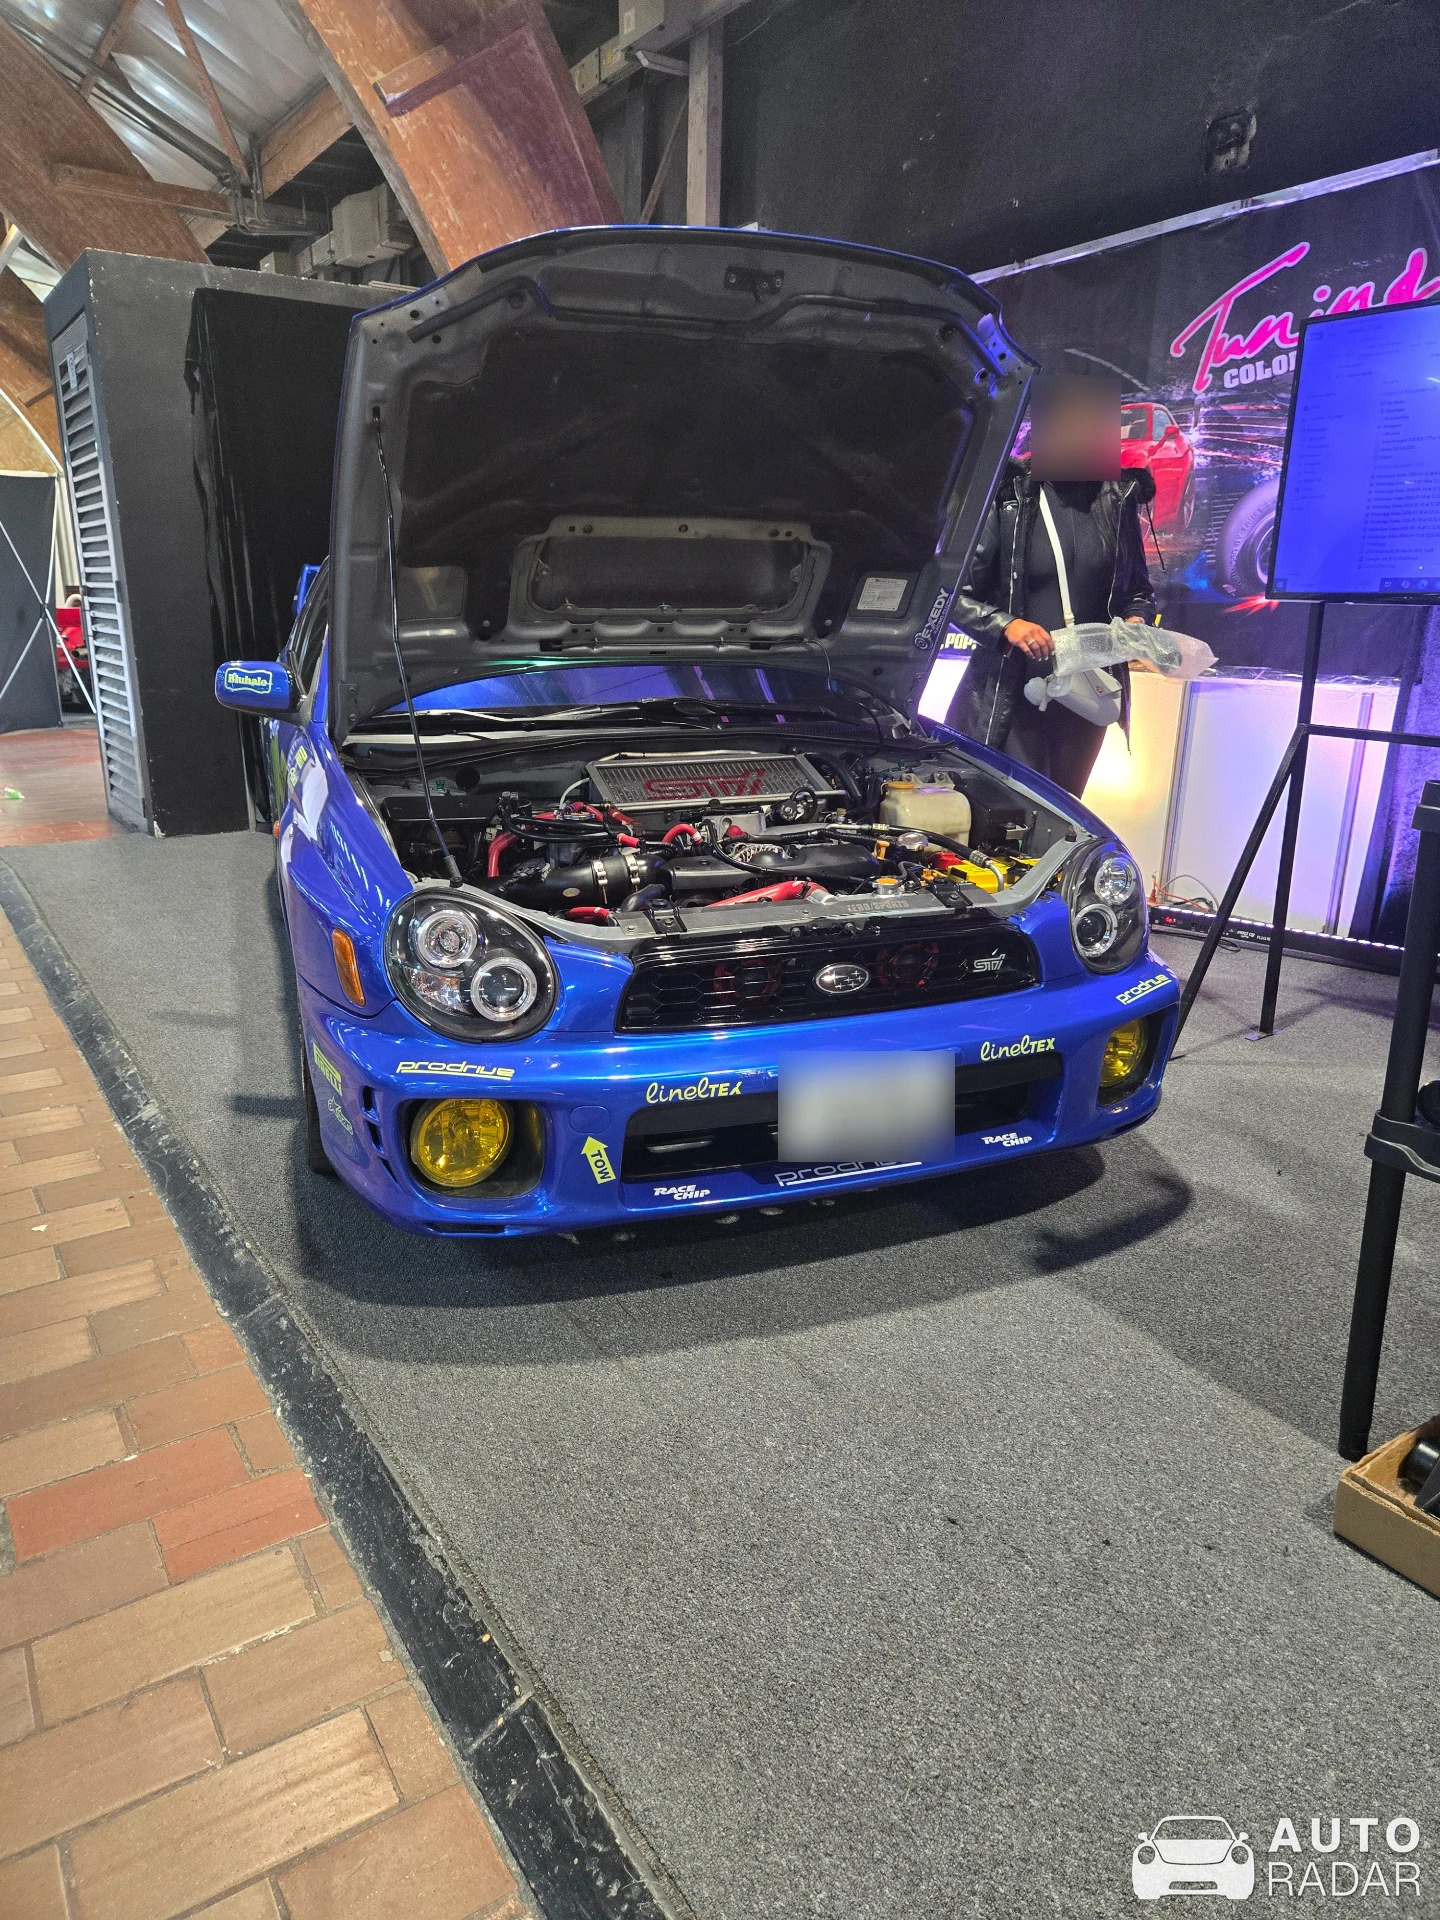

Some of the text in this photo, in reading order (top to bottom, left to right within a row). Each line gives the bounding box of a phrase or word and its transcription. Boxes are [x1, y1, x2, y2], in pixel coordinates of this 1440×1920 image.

[921, 587, 949, 639] EXEDY
[1115, 974, 1170, 1005] prodrive
[312, 1041, 343, 1097] PIRELLI
[396, 1061, 515, 1079] prodrive
[981, 1132, 1018, 1144] RACE
[1002, 1136, 1033, 1147] CHIP
[590, 1149, 612, 1181] TOW
[653, 1184, 697, 1196] RACE
[673, 1188, 711, 1200] CHIP
